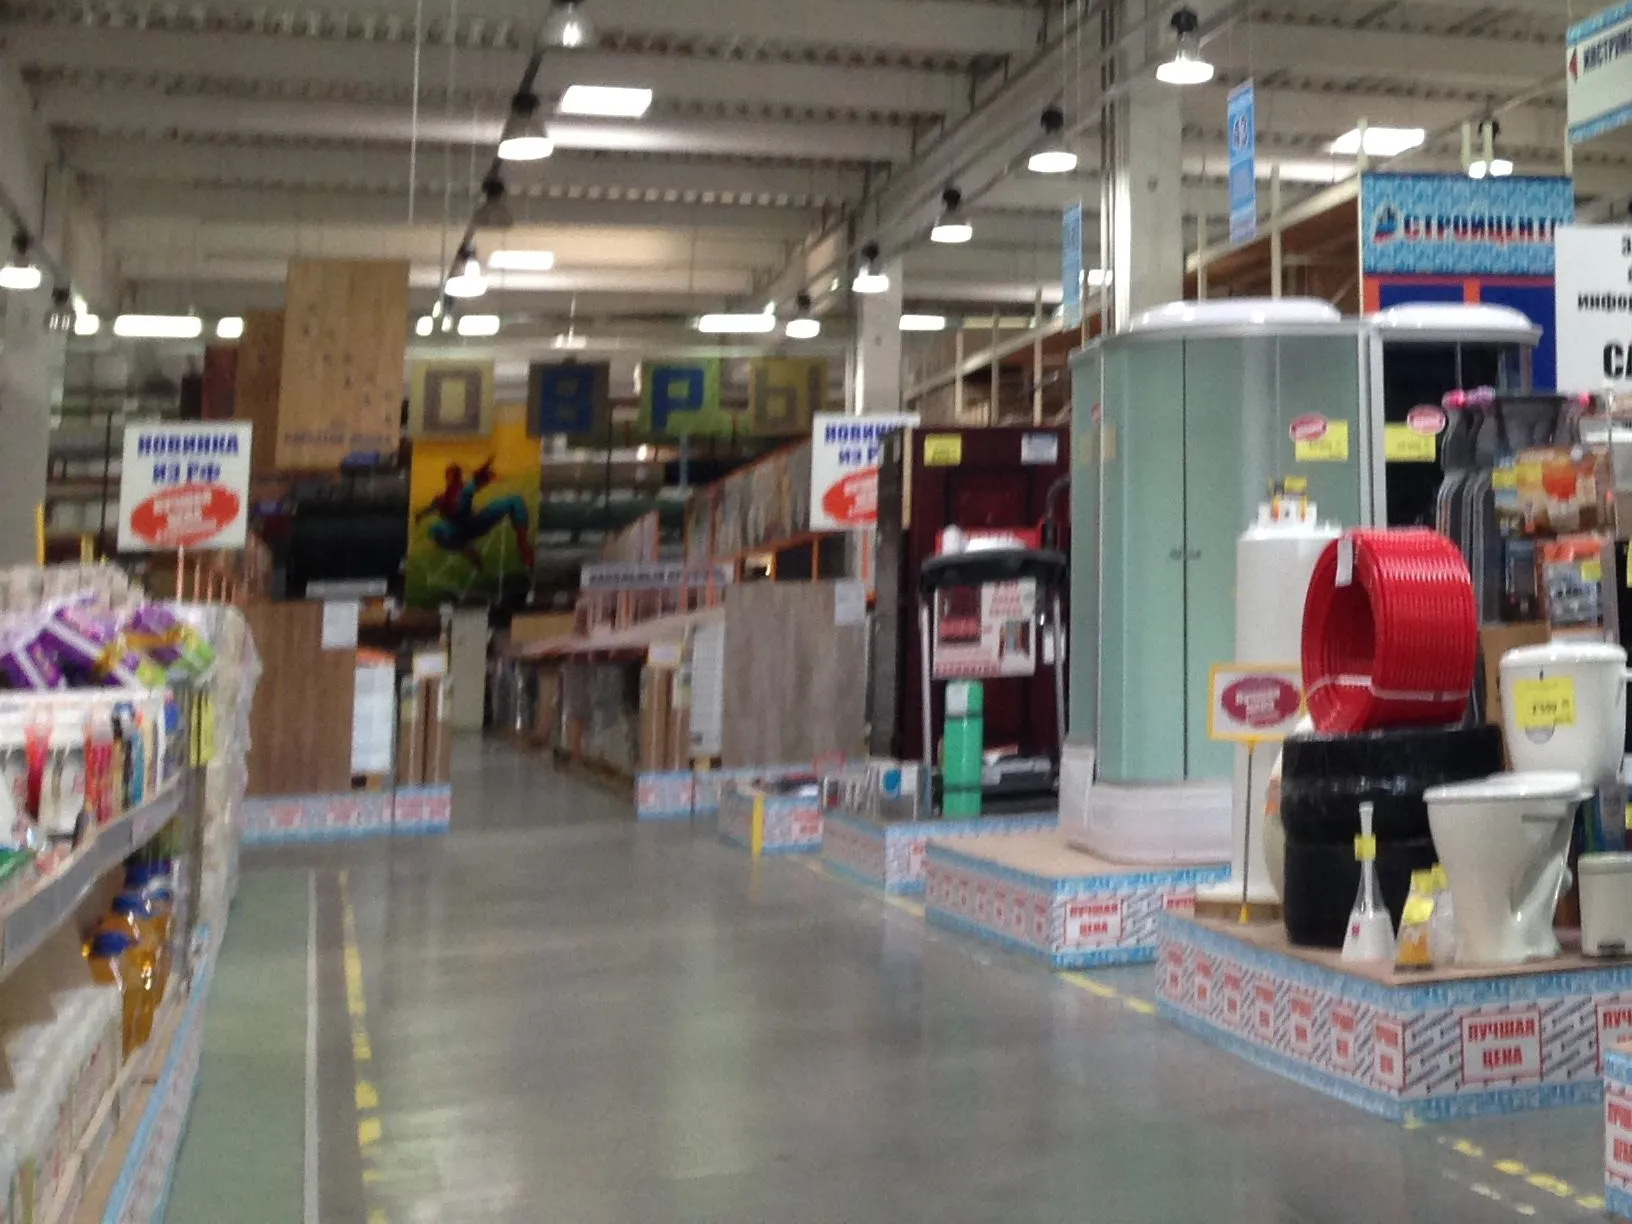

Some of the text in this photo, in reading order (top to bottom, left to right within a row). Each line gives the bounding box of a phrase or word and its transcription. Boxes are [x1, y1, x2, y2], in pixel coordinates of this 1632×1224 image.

[137, 433, 240, 457] НОВИНКА
[1468, 1017, 1536, 1043] ЛУЧШАЯ
[1482, 1045, 1523, 1071] ЦЕНА
